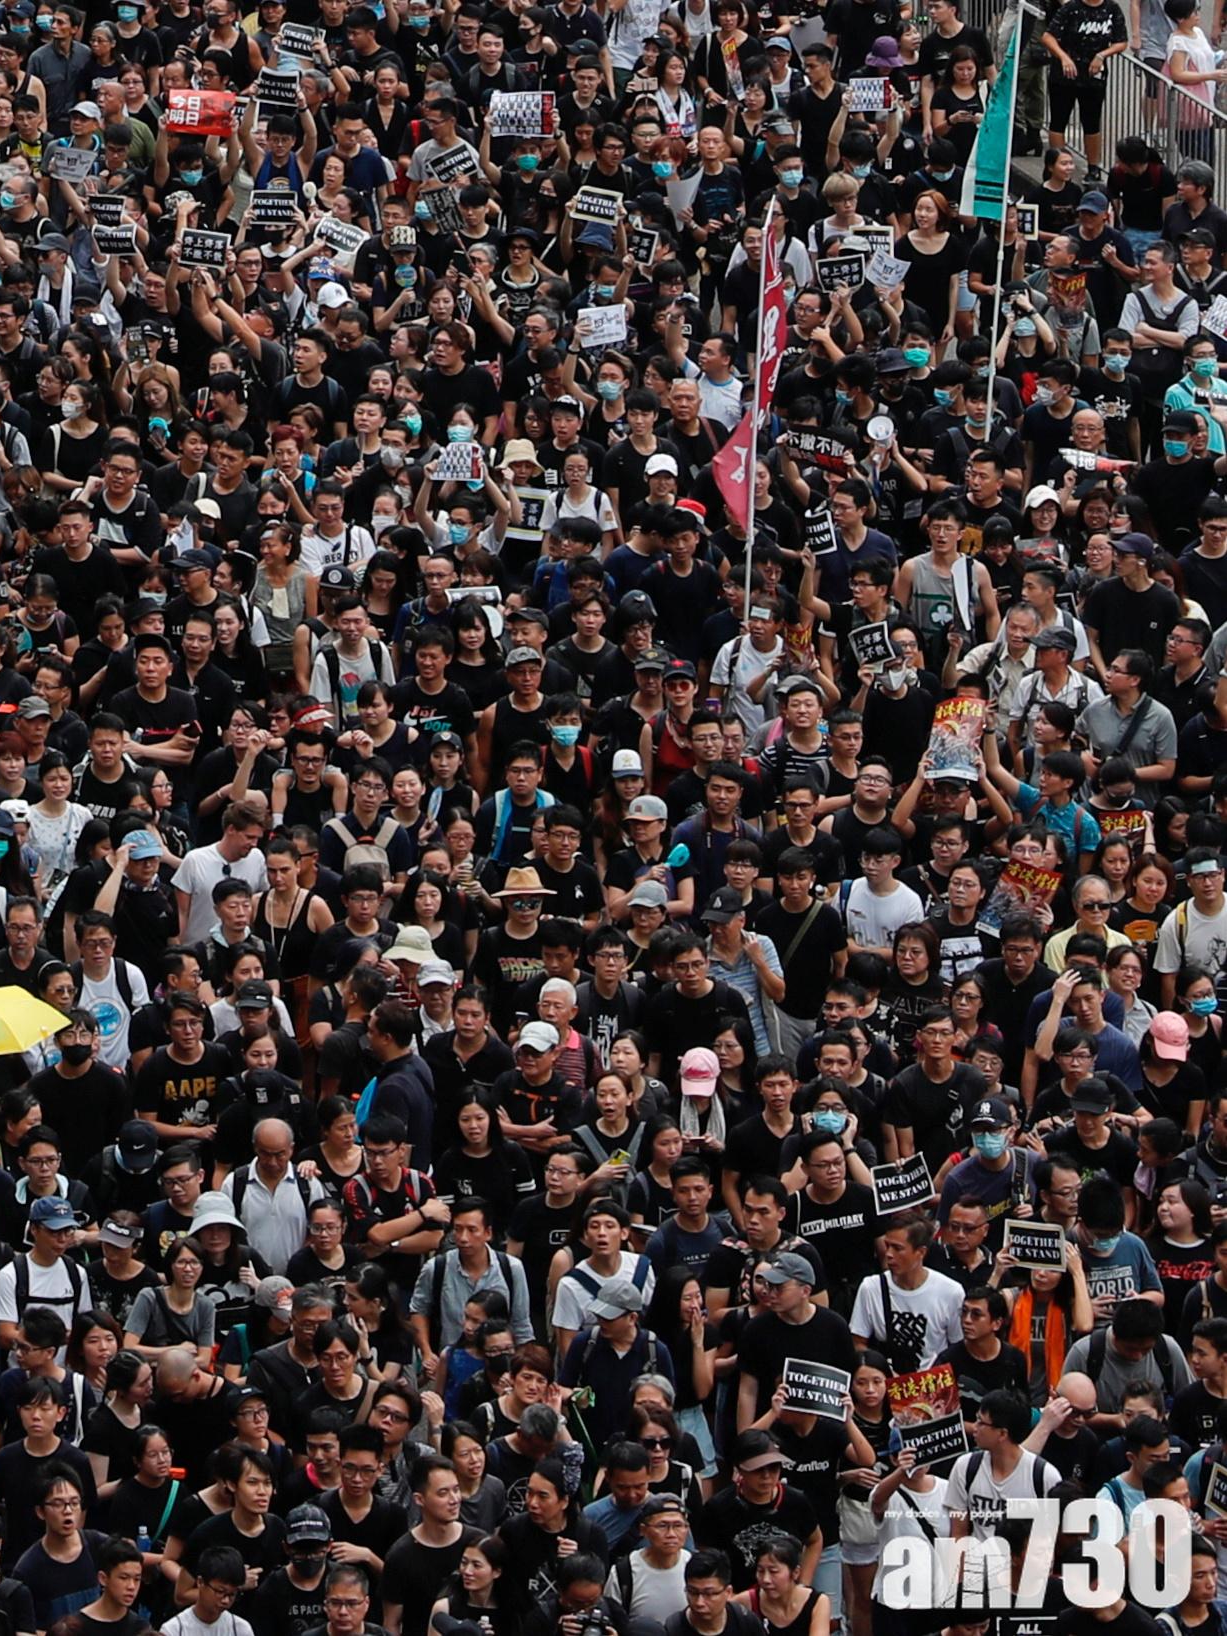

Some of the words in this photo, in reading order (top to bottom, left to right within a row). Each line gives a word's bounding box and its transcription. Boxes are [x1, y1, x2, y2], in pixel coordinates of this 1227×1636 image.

[877, 1165, 926, 1188] TOGETHER
[880, 1191, 895, 1203] WE
[895, 1179, 929, 1199] STAND
[825, 1213, 864, 1229] MILITARY
[1025, 1248, 1060, 1260] STAND
[787, 1371, 846, 1392] TOGETHER
[789, 1387, 805, 1399] WE
[903, 1422, 963, 1448] TOGETHER
[1016, 1623, 1042, 1635] ALL
